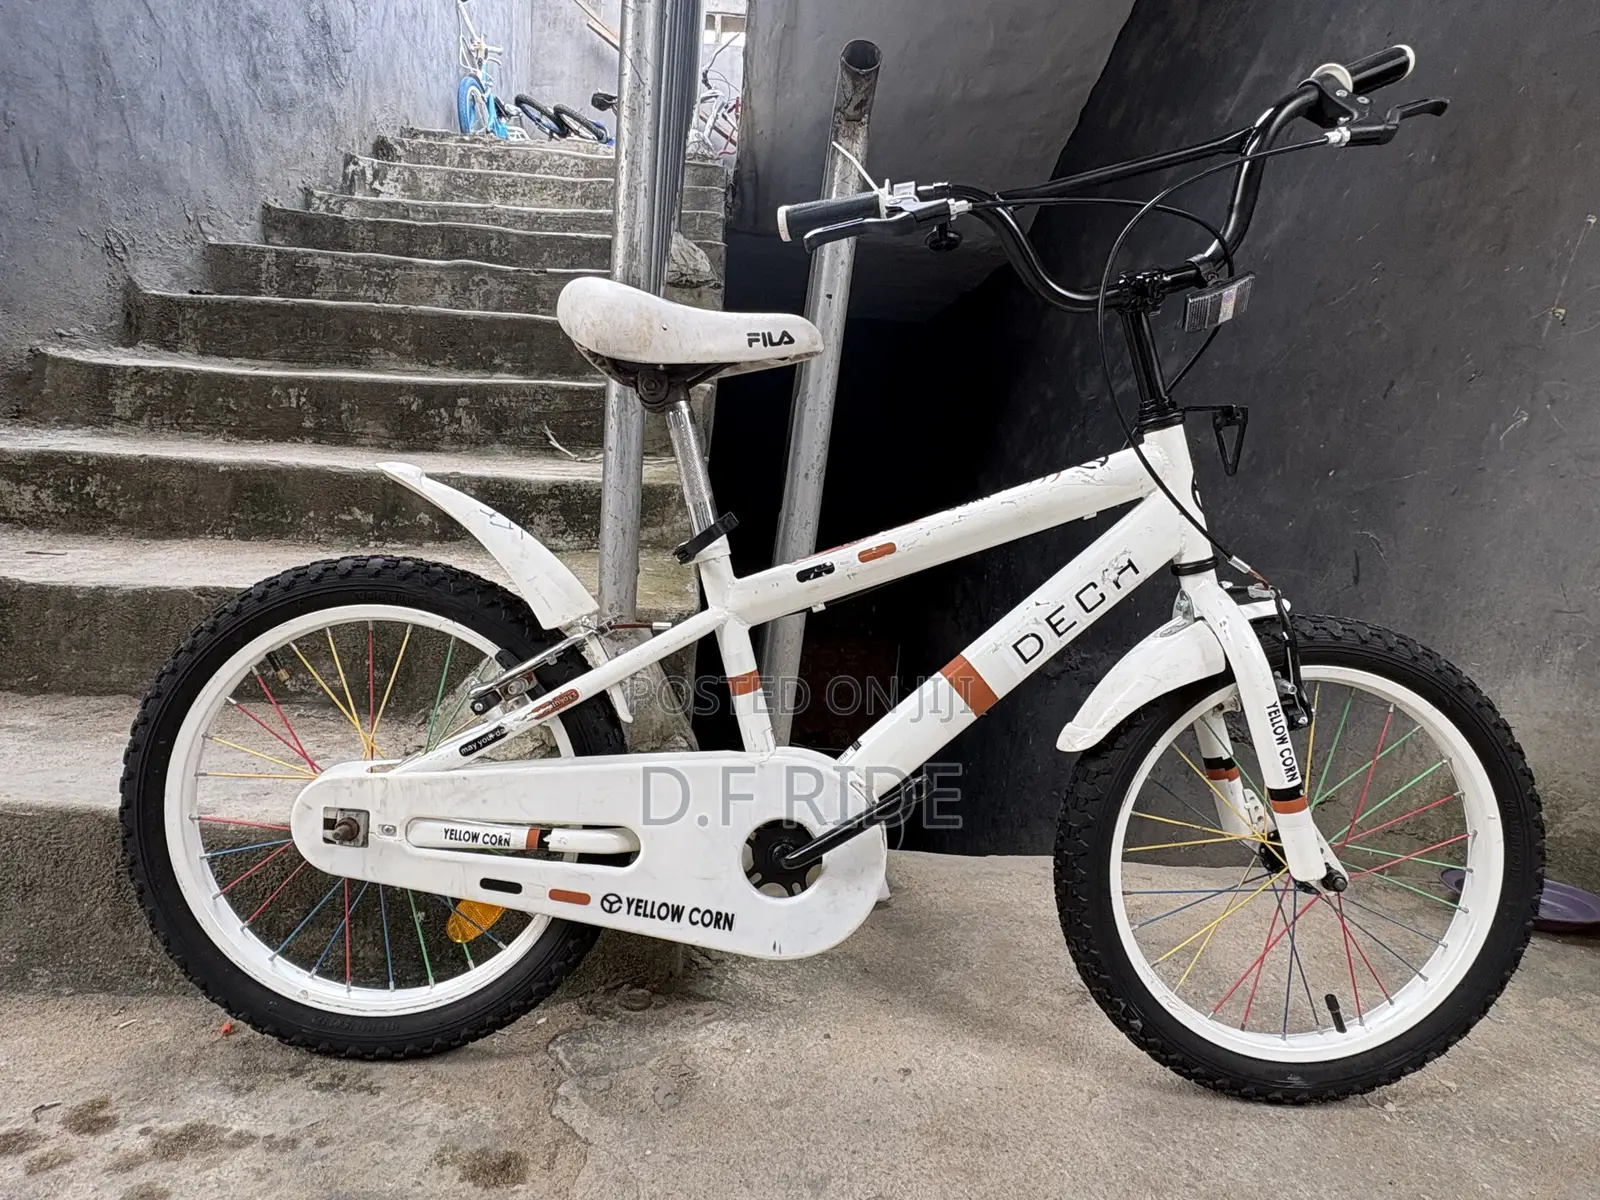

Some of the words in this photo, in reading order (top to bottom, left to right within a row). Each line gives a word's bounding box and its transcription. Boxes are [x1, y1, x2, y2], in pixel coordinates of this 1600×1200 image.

[746, 330, 796, 348] FILA
[460, 742, 478, 755] may
[1266, 701, 1289, 744] YELLOW
[1279, 748, 1299, 782] CORN
[443, 827, 481, 844] YELLOW
[481, 832, 512, 848] CORN
[626, 897, 685, 923] YELLOW
[688, 906, 736, 932] CORN
